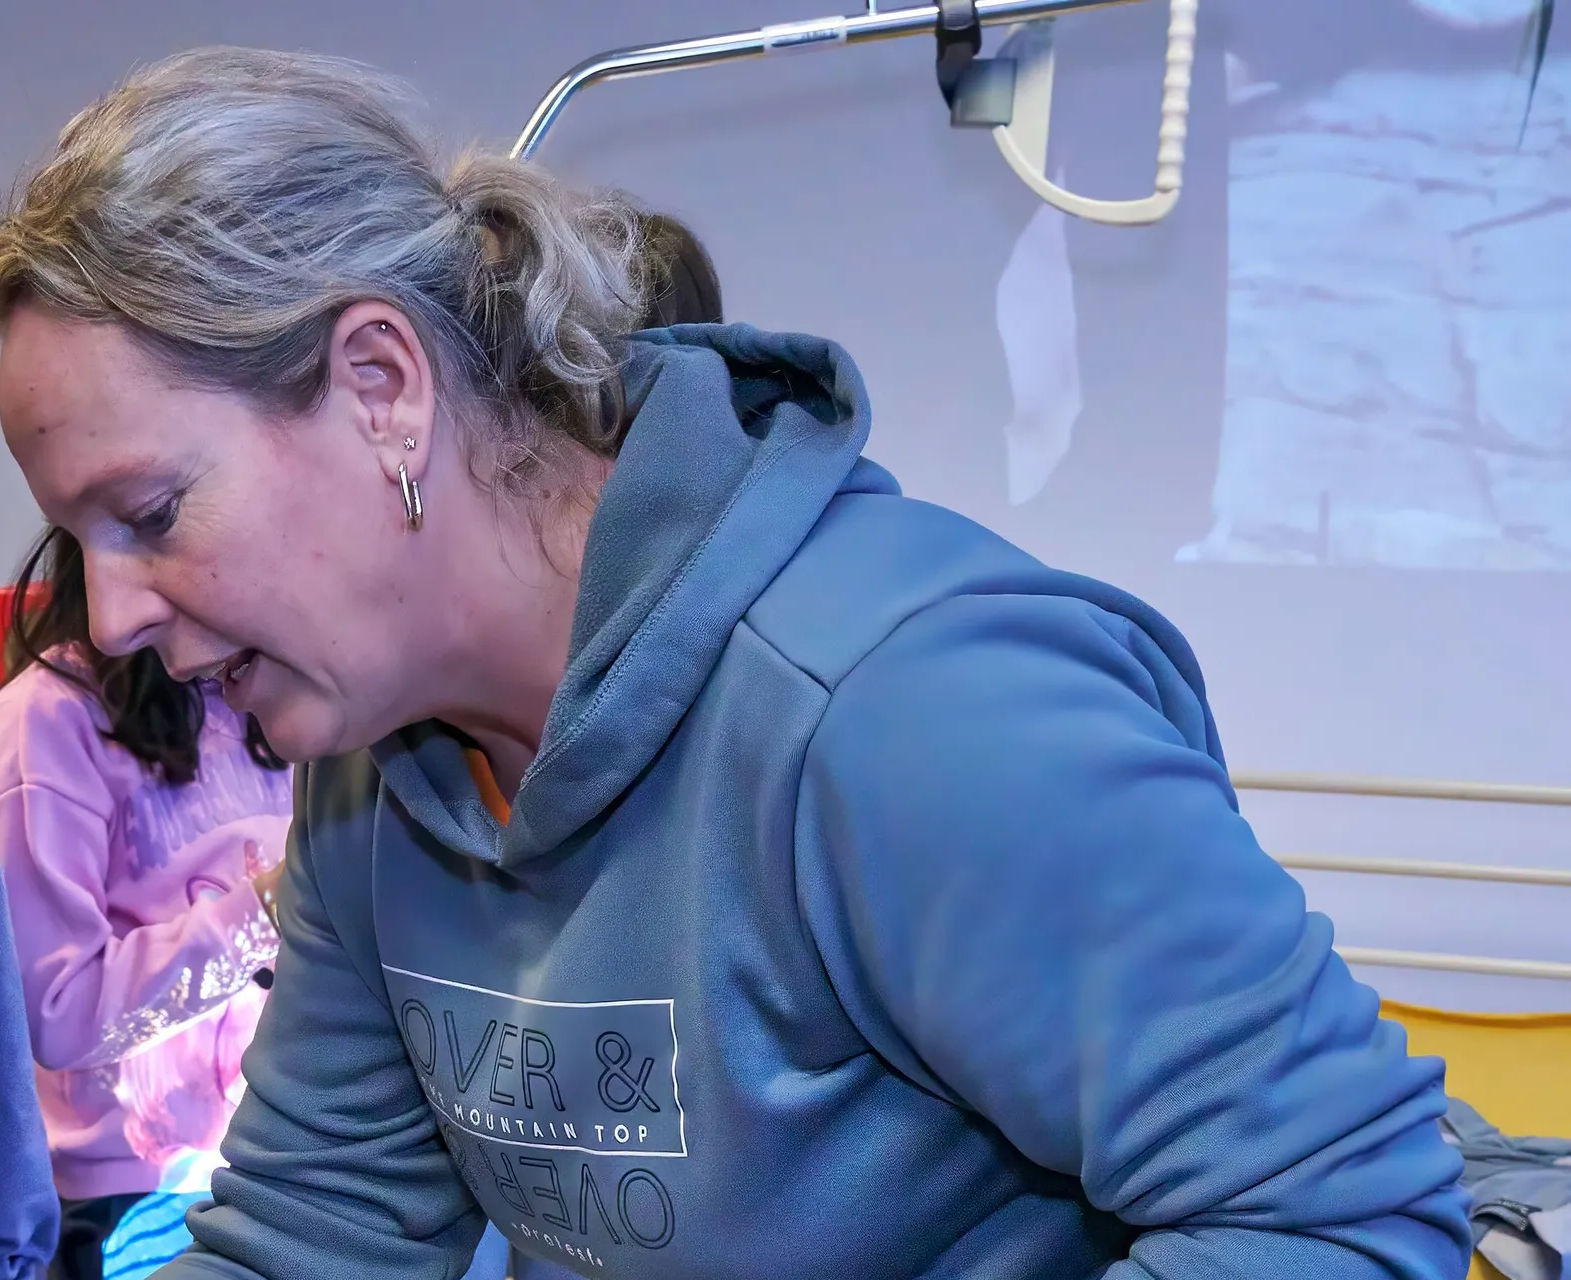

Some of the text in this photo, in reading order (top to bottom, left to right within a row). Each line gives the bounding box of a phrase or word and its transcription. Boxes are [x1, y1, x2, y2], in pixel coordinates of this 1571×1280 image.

[596, 1031, 660, 1113] &
[454, 1104, 577, 1139] MOUNTAIN
[595, 1124, 648, 1143] TOP
